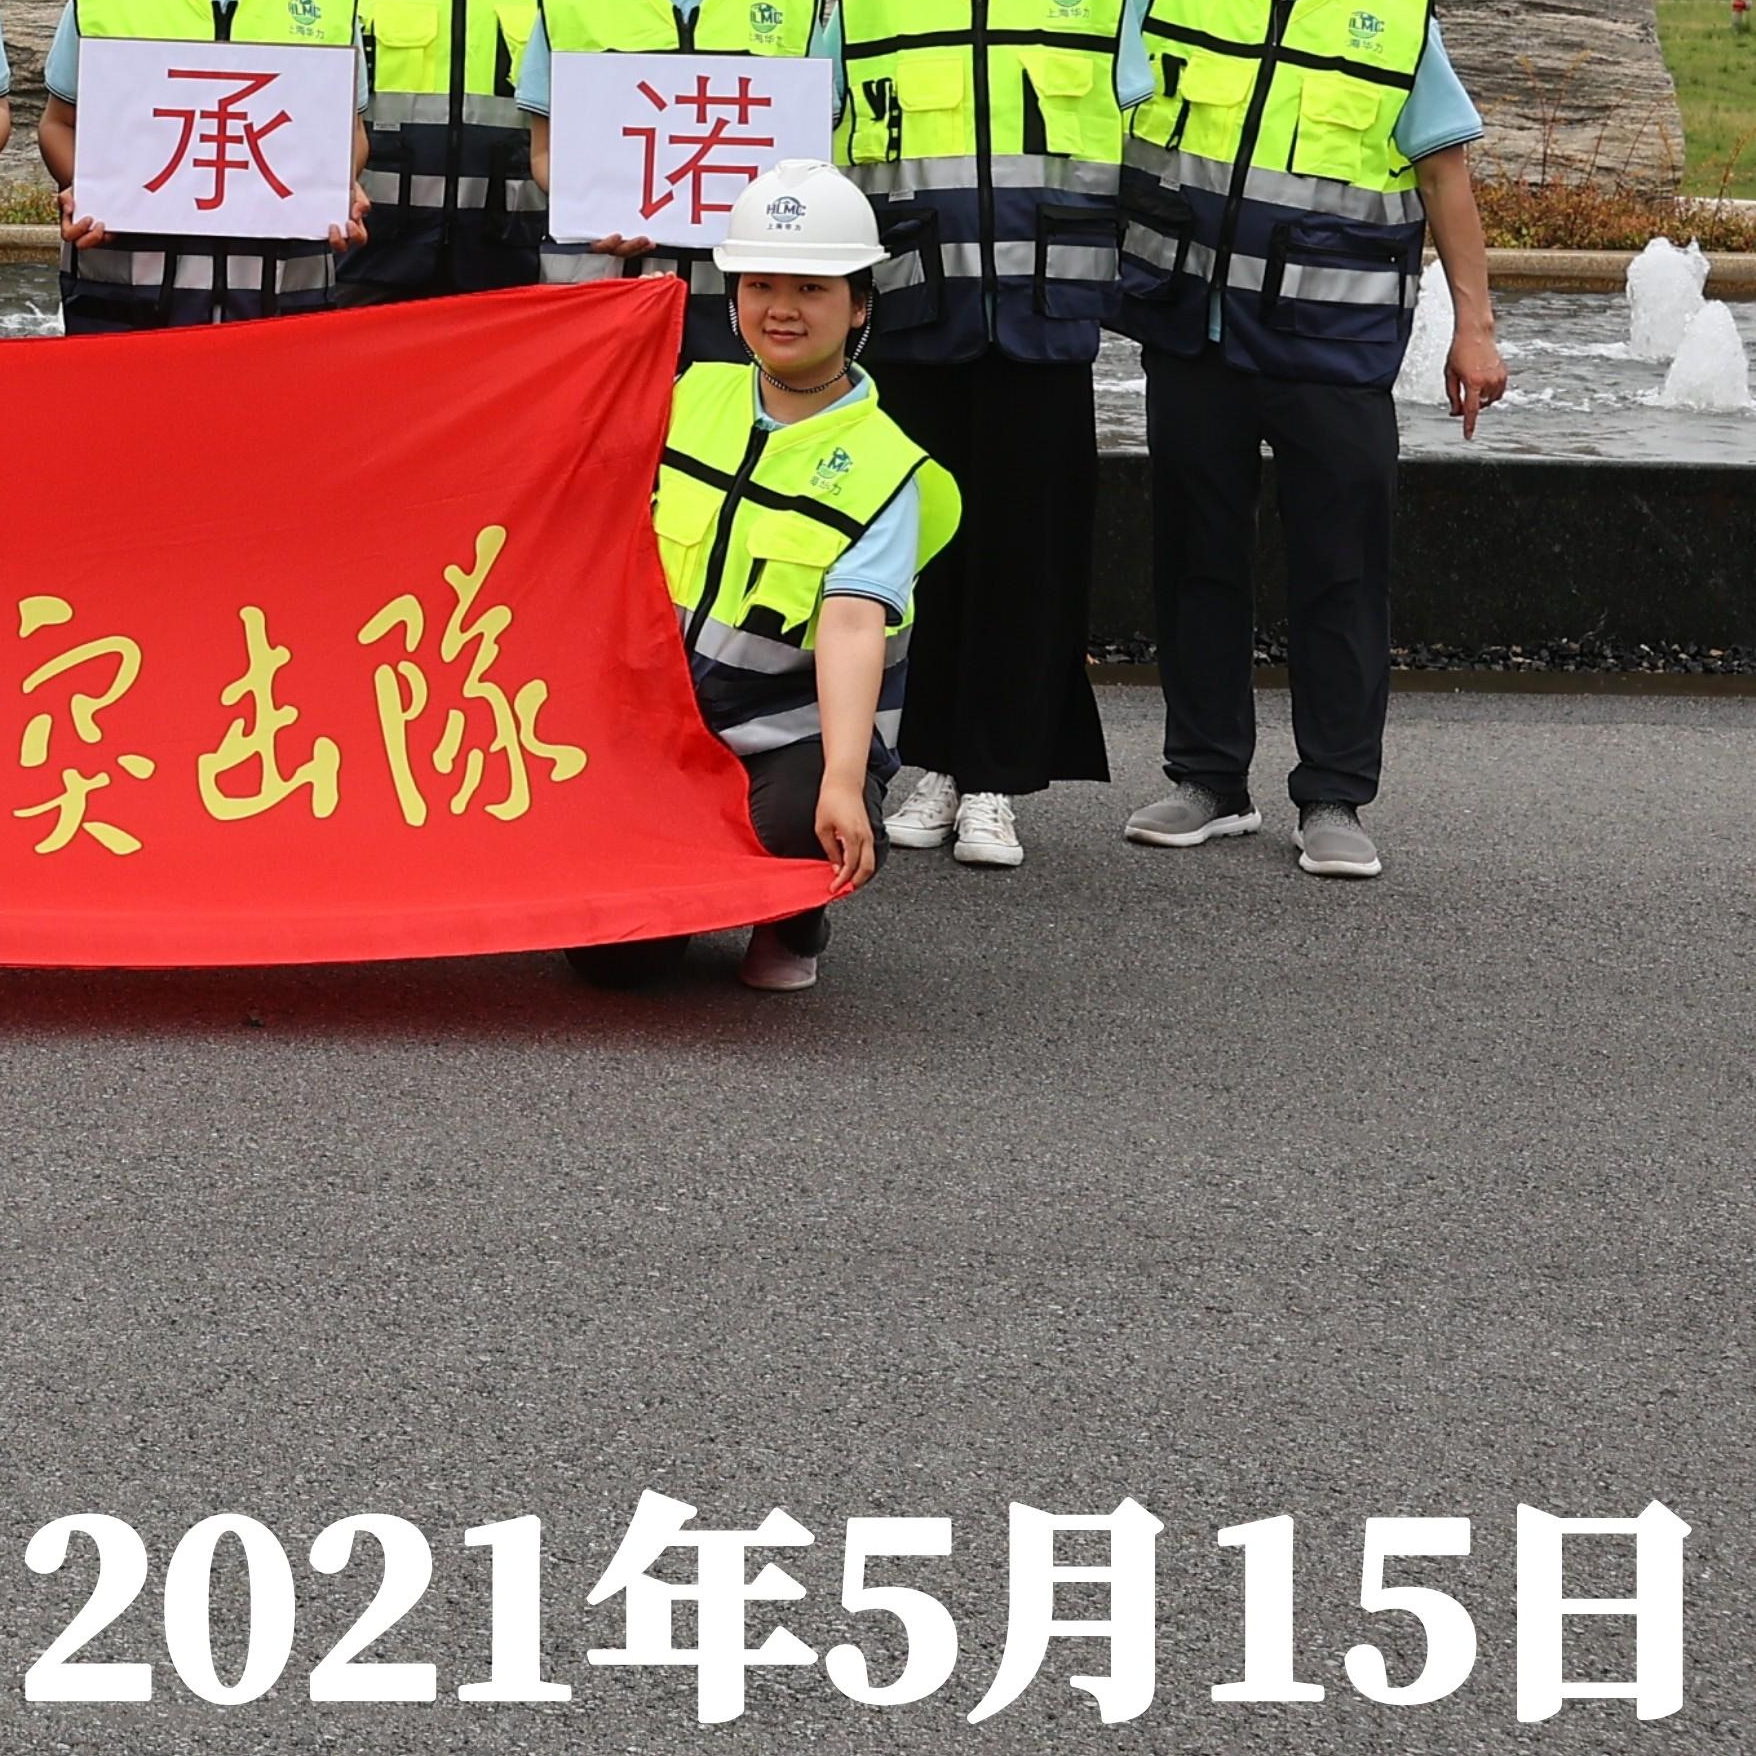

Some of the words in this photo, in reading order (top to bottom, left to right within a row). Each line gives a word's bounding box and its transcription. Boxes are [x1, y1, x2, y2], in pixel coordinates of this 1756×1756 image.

[147, 70, 290, 210] 承
[625, 77, 772, 222] 诺
[766, 203, 806, 216] HLMC
